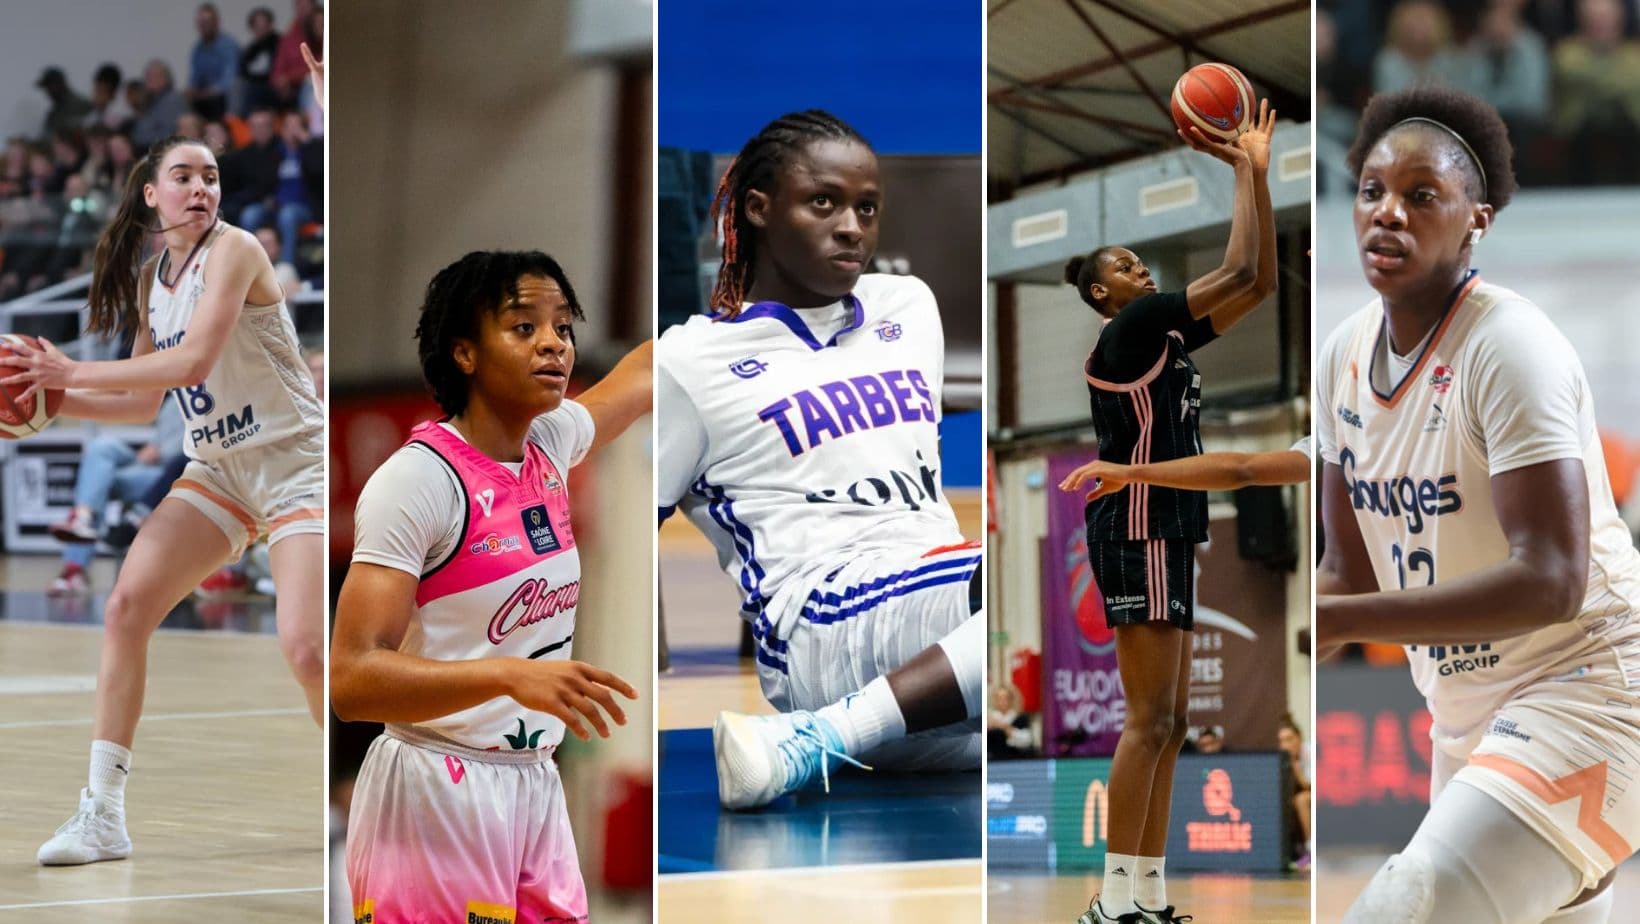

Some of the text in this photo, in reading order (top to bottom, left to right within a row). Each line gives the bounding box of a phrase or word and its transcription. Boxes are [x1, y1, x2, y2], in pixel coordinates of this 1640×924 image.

[171, 381, 215, 421] 18
[757, 369, 937, 458] TARBES
[191, 404, 254, 448] PHM
[221, 423, 261, 449] GROUP
[1438, 654, 1500, 677] GROUP
